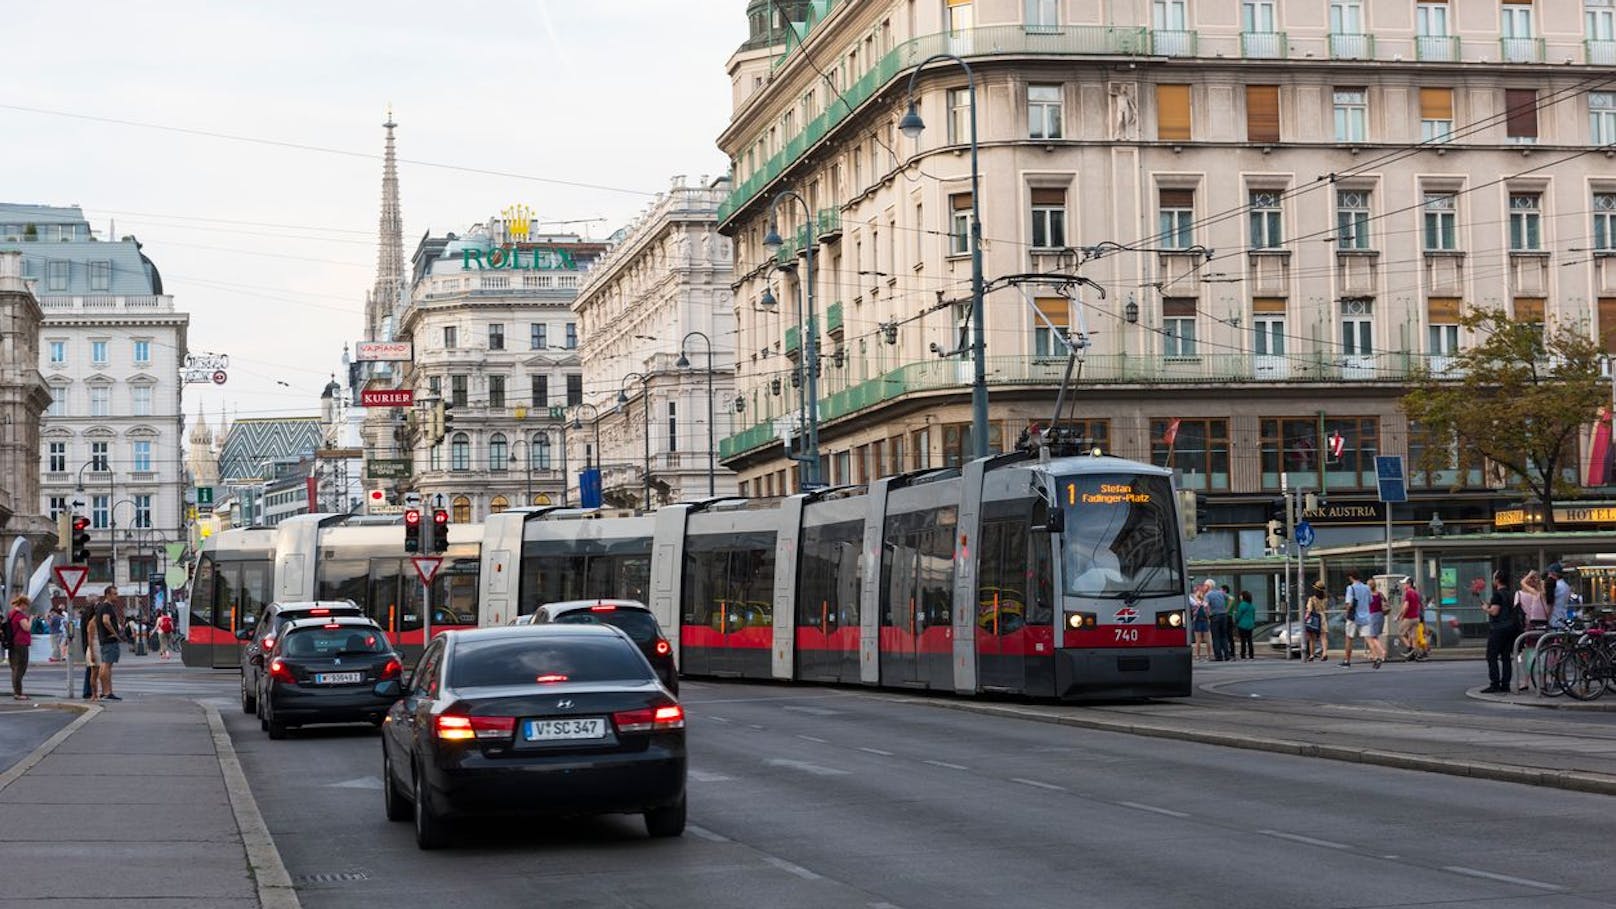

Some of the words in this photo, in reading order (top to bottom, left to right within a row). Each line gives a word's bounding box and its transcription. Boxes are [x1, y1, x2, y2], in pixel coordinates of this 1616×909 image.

[462, 247, 577, 270] ROLEX
[364, 394, 410, 403] KURIER
[1067, 483, 1075, 505] 1
[1100, 484, 1132, 493] Stefan
[1082, 493, 1150, 503] Fadinger-Platz
[1329, 506, 1376, 517] AUSTRIA
[1114, 629, 1138, 642] 740
[535, 721, 545, 735] V
[553, 721, 570, 735] SC
[573, 720, 597, 734] 347
